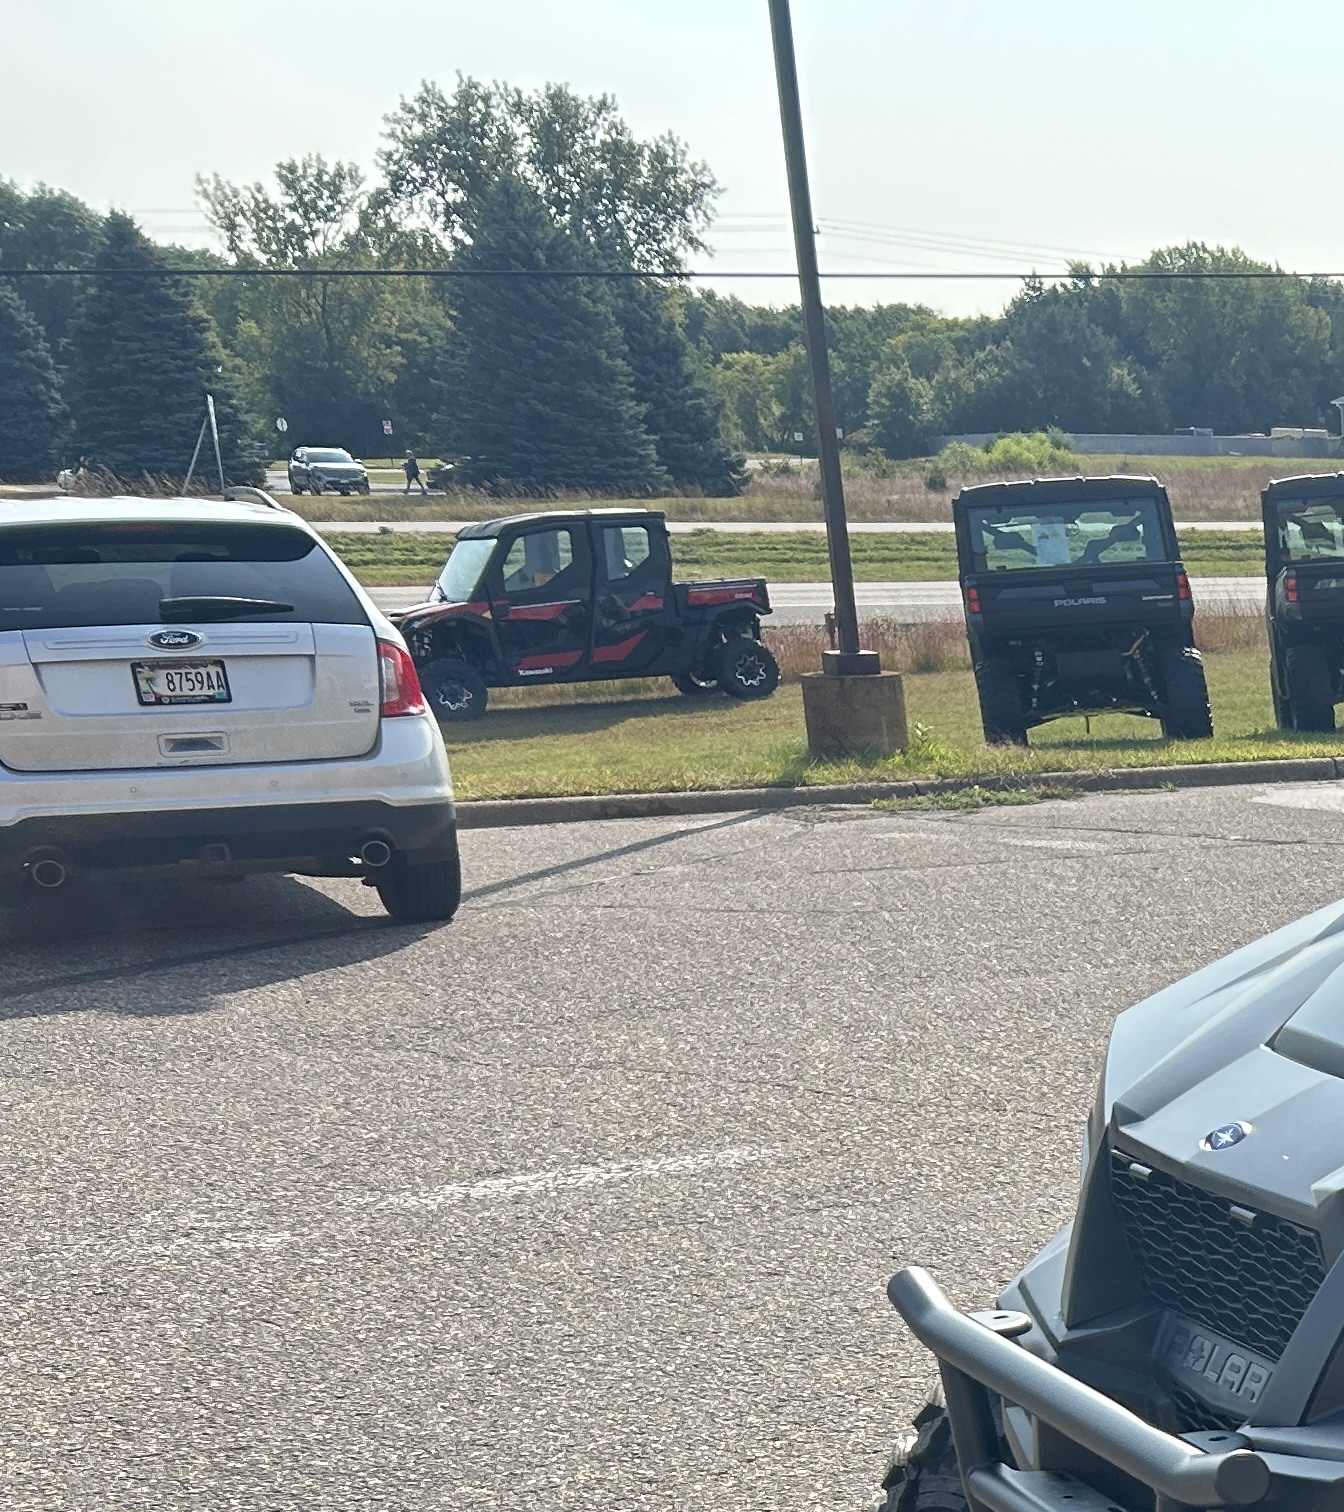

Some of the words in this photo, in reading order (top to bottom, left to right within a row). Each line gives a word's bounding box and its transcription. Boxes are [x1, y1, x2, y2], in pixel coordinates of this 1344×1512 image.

[1053, 596, 1107, 608] POLARIS
[160, 632, 189, 645] Ford
[165, 670, 226, 693] 8759AA
[1166, 1326, 1270, 1404] POLAR
